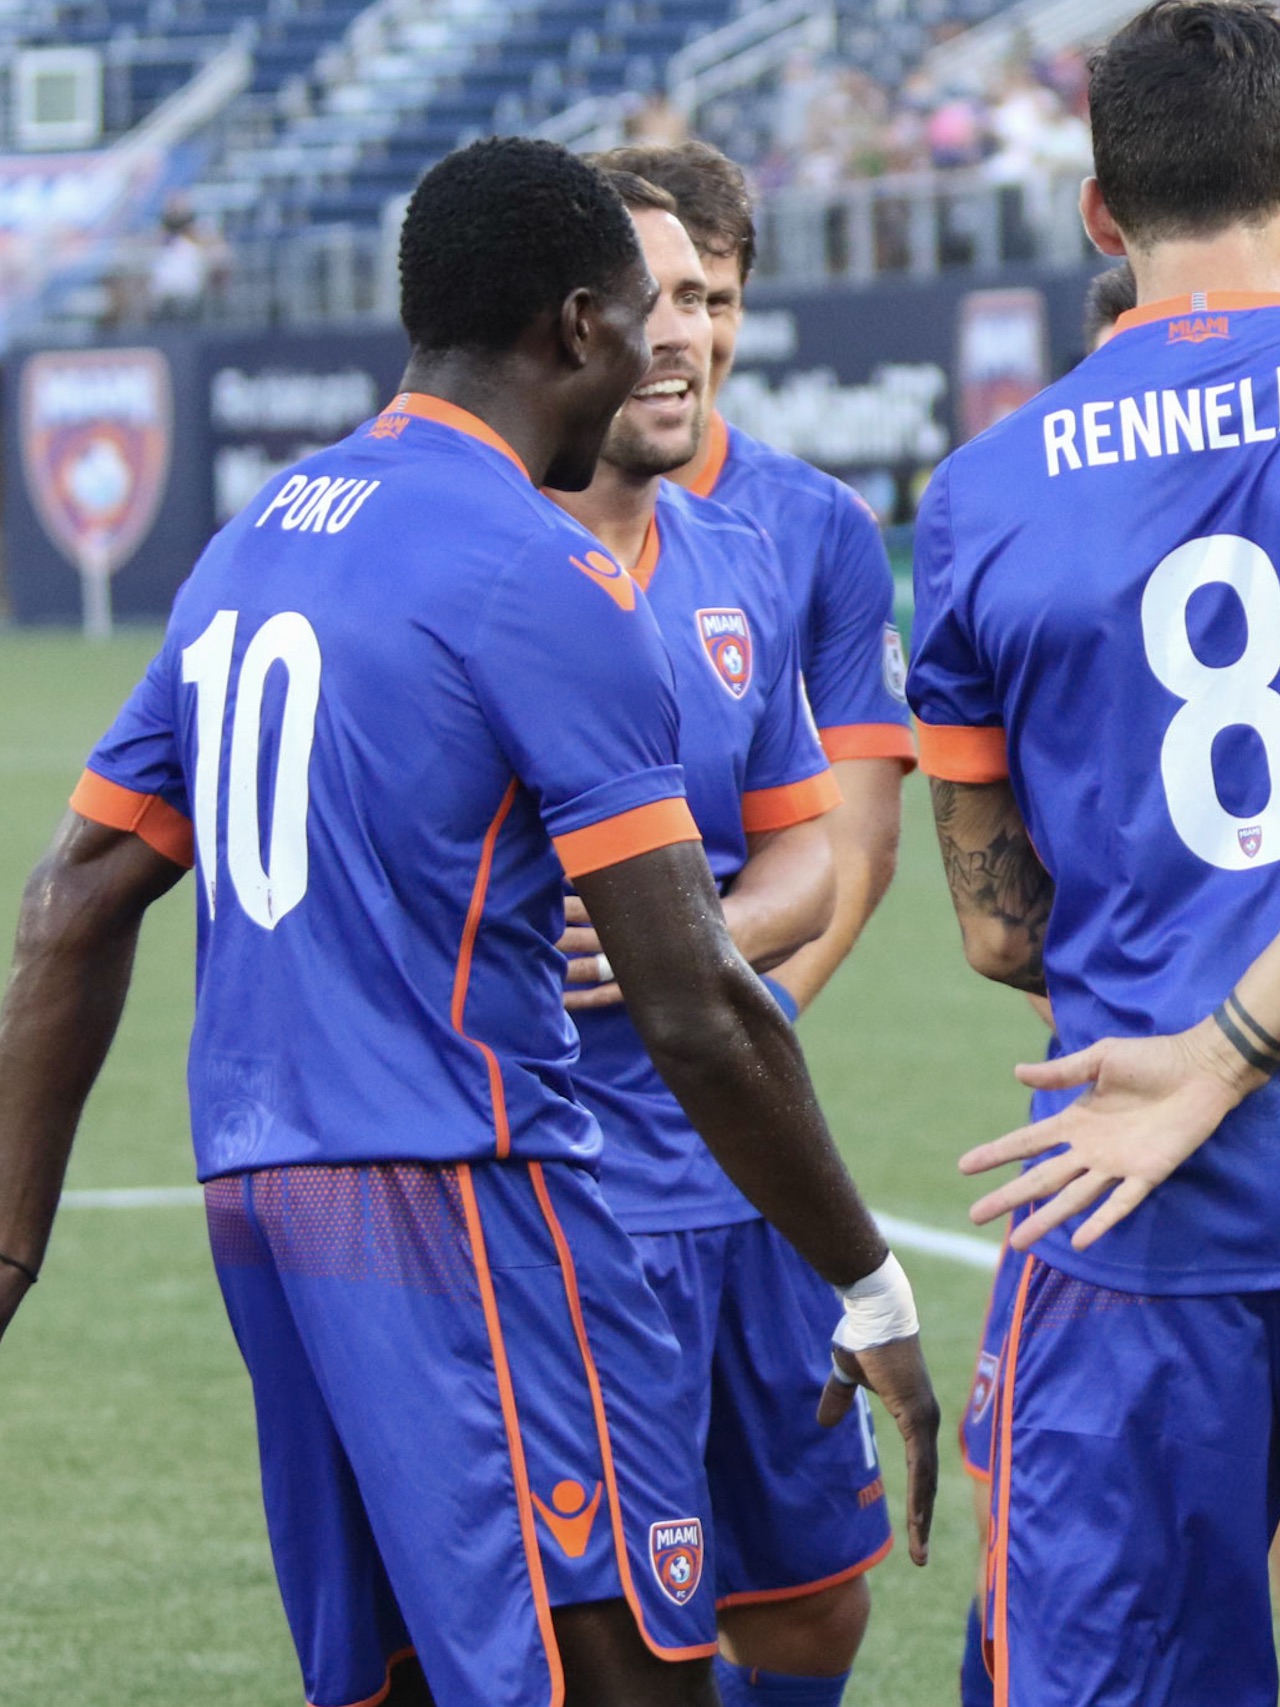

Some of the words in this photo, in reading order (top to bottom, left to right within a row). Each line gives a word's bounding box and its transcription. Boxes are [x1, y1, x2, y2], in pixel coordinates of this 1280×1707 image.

[254, 474, 382, 534] POKU
[702, 614, 745, 638] MIAMI
[181, 610, 322, 931] 10
[656, 1525, 698, 1551] MIAMI
